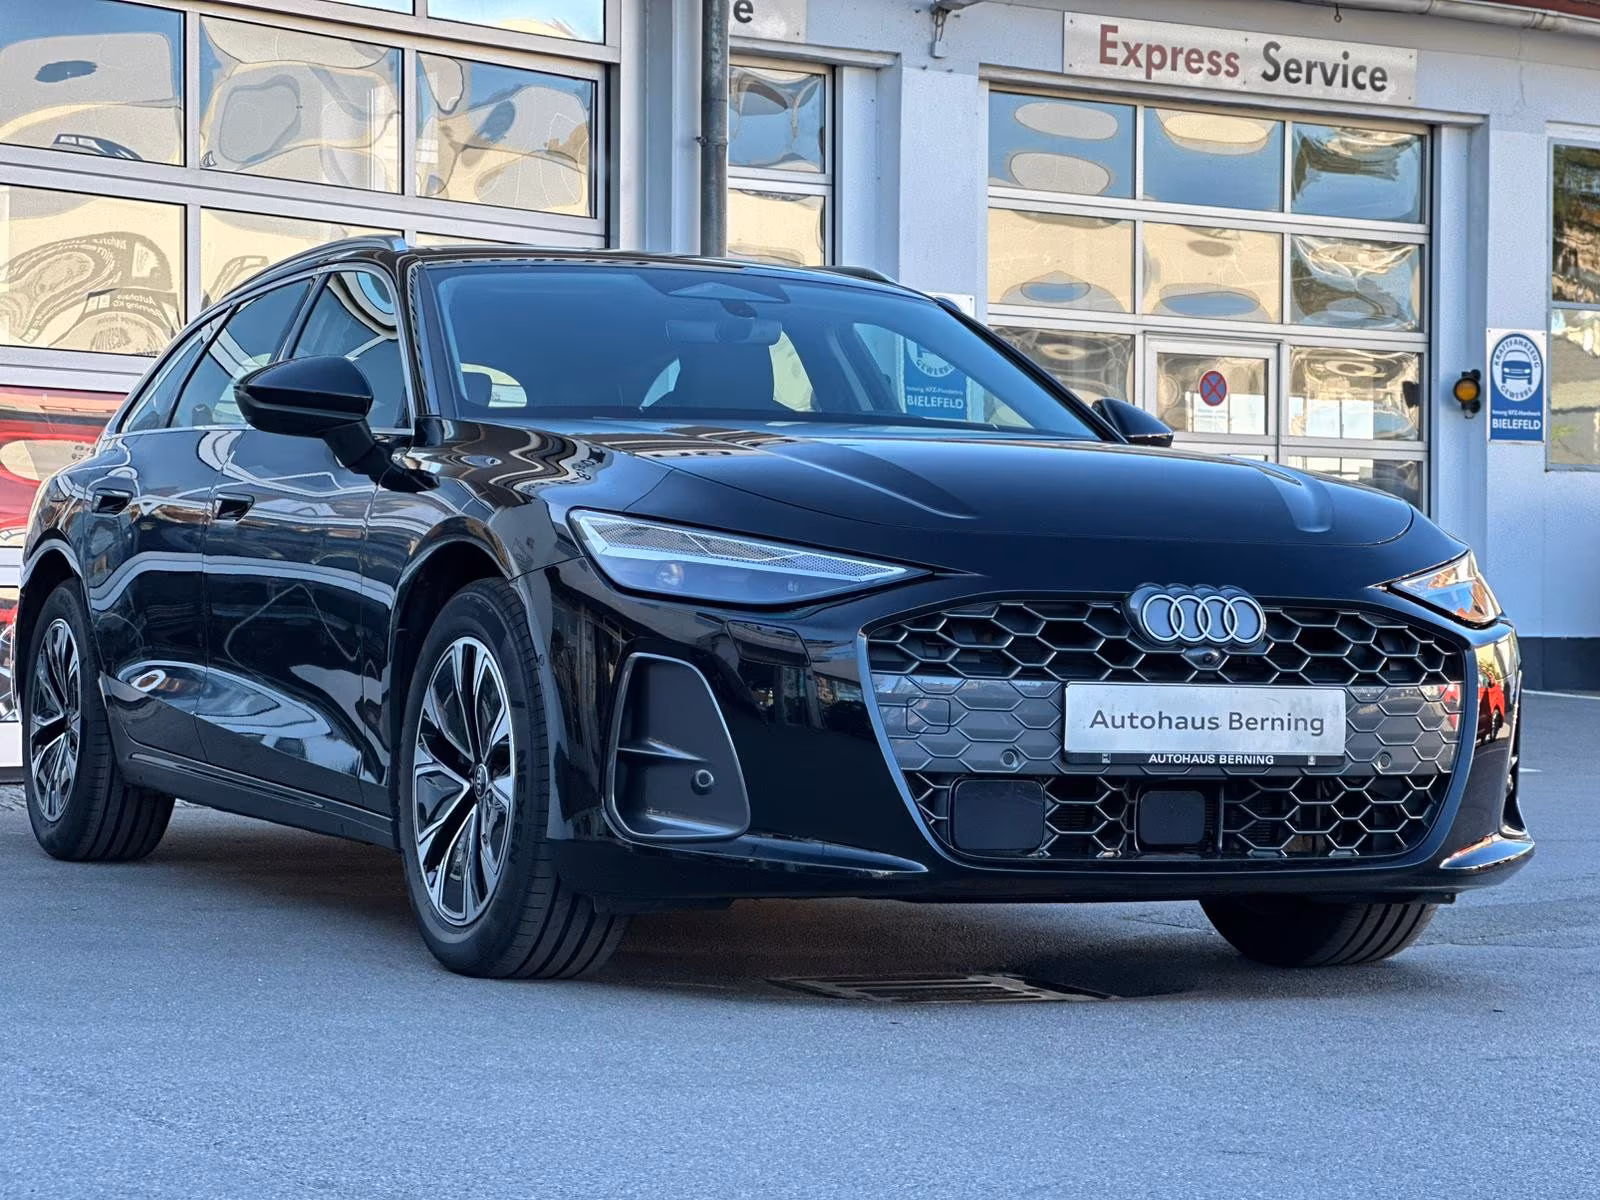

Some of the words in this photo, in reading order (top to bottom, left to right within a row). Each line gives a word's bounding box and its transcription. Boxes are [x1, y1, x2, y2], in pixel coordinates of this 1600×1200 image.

[1099, 24, 1240, 80] Express
[1261, 41, 1388, 92] Service
[1495, 339, 1540, 368] KRAFTFAHRZEUG
[1501, 385, 1532, 399] GEWERBE
[907, 395, 964, 409] BIELEFELD
[1492, 418, 1541, 430] BIELEFELD
[1089, 710, 1219, 732] Autohaus
[1228, 711, 1325, 737] Berning
[1148, 753, 1216, 764] AUTOHAUS
[1219, 754, 1275, 765] BERNING
